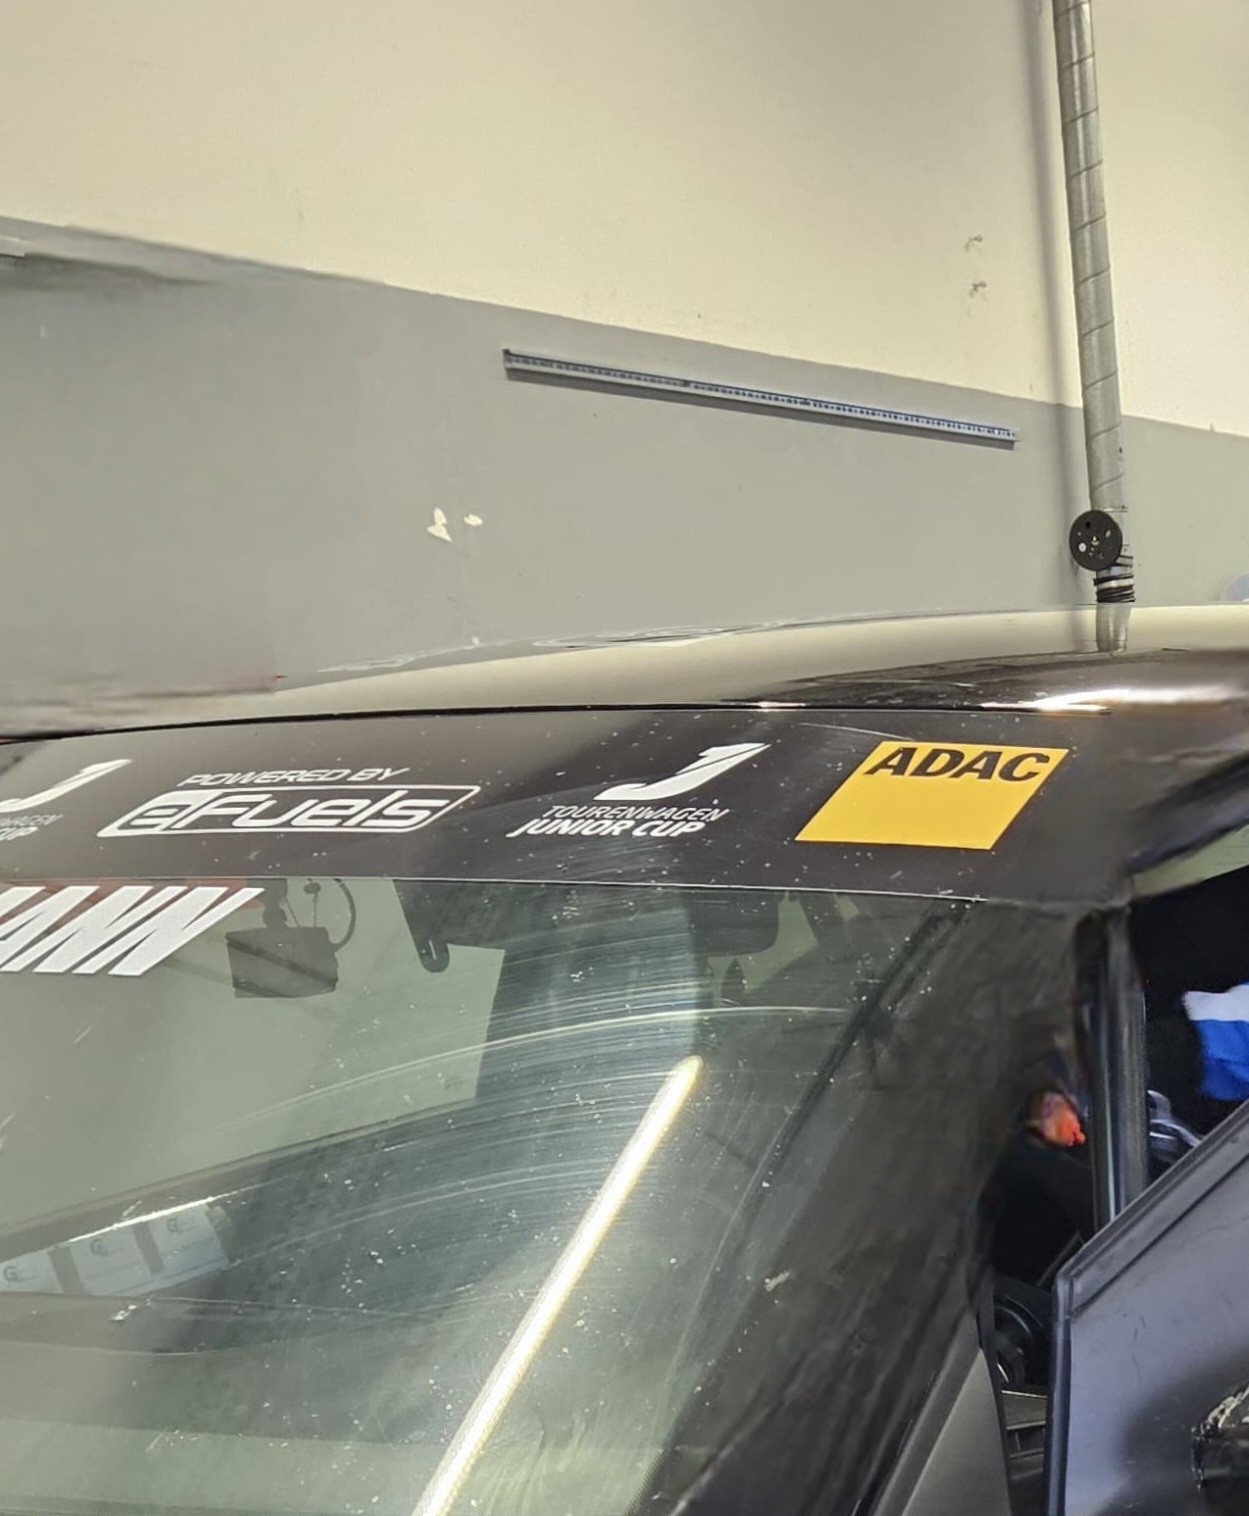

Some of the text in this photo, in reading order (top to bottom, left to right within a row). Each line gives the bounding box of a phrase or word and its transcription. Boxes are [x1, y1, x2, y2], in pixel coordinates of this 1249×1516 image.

[864, 746, 1051, 783] ADAC
[177, 767, 411, 787] POWERED BY
[542, 804, 730, 822] TOURENWAGEN
[505, 817, 706, 838] JUNIOR CUP
